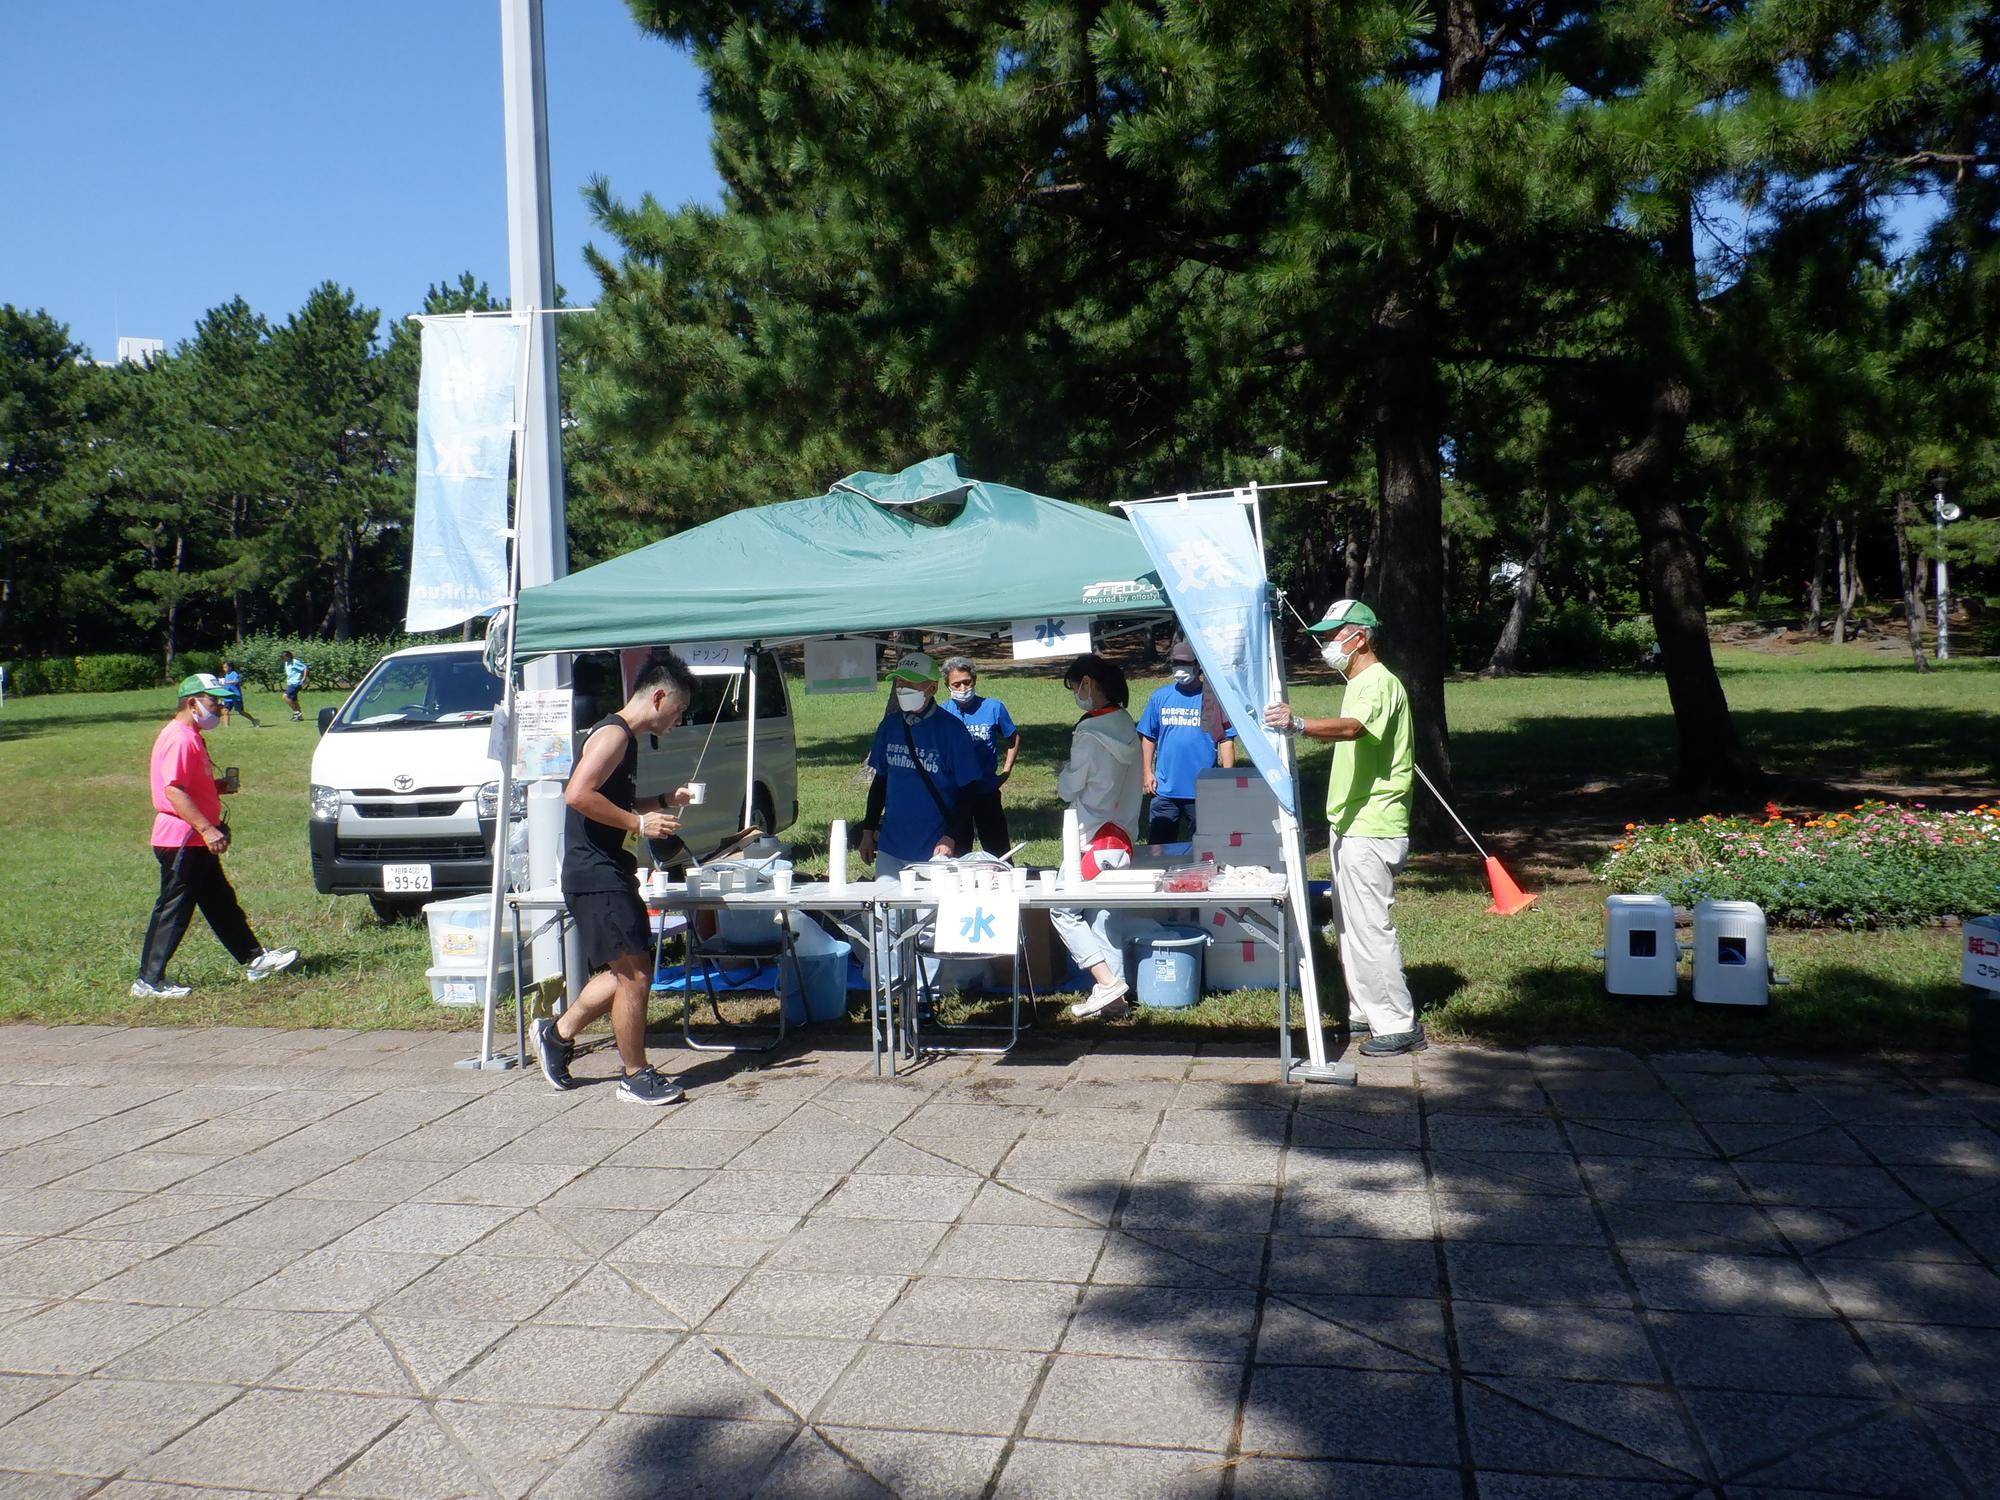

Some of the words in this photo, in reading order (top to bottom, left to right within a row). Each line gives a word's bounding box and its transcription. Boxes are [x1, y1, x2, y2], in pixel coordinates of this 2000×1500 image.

[1082, 594, 1116, 604] Powered
[1119, 594, 1129, 604] by
[1034, 618, 1067, 648] 水
[693, 648, 728, 663] ドリンク
[395, 876, 429, 889] 99-62
[959, 906, 996, 943] 水
[1976, 963, 2000, 978] こち
